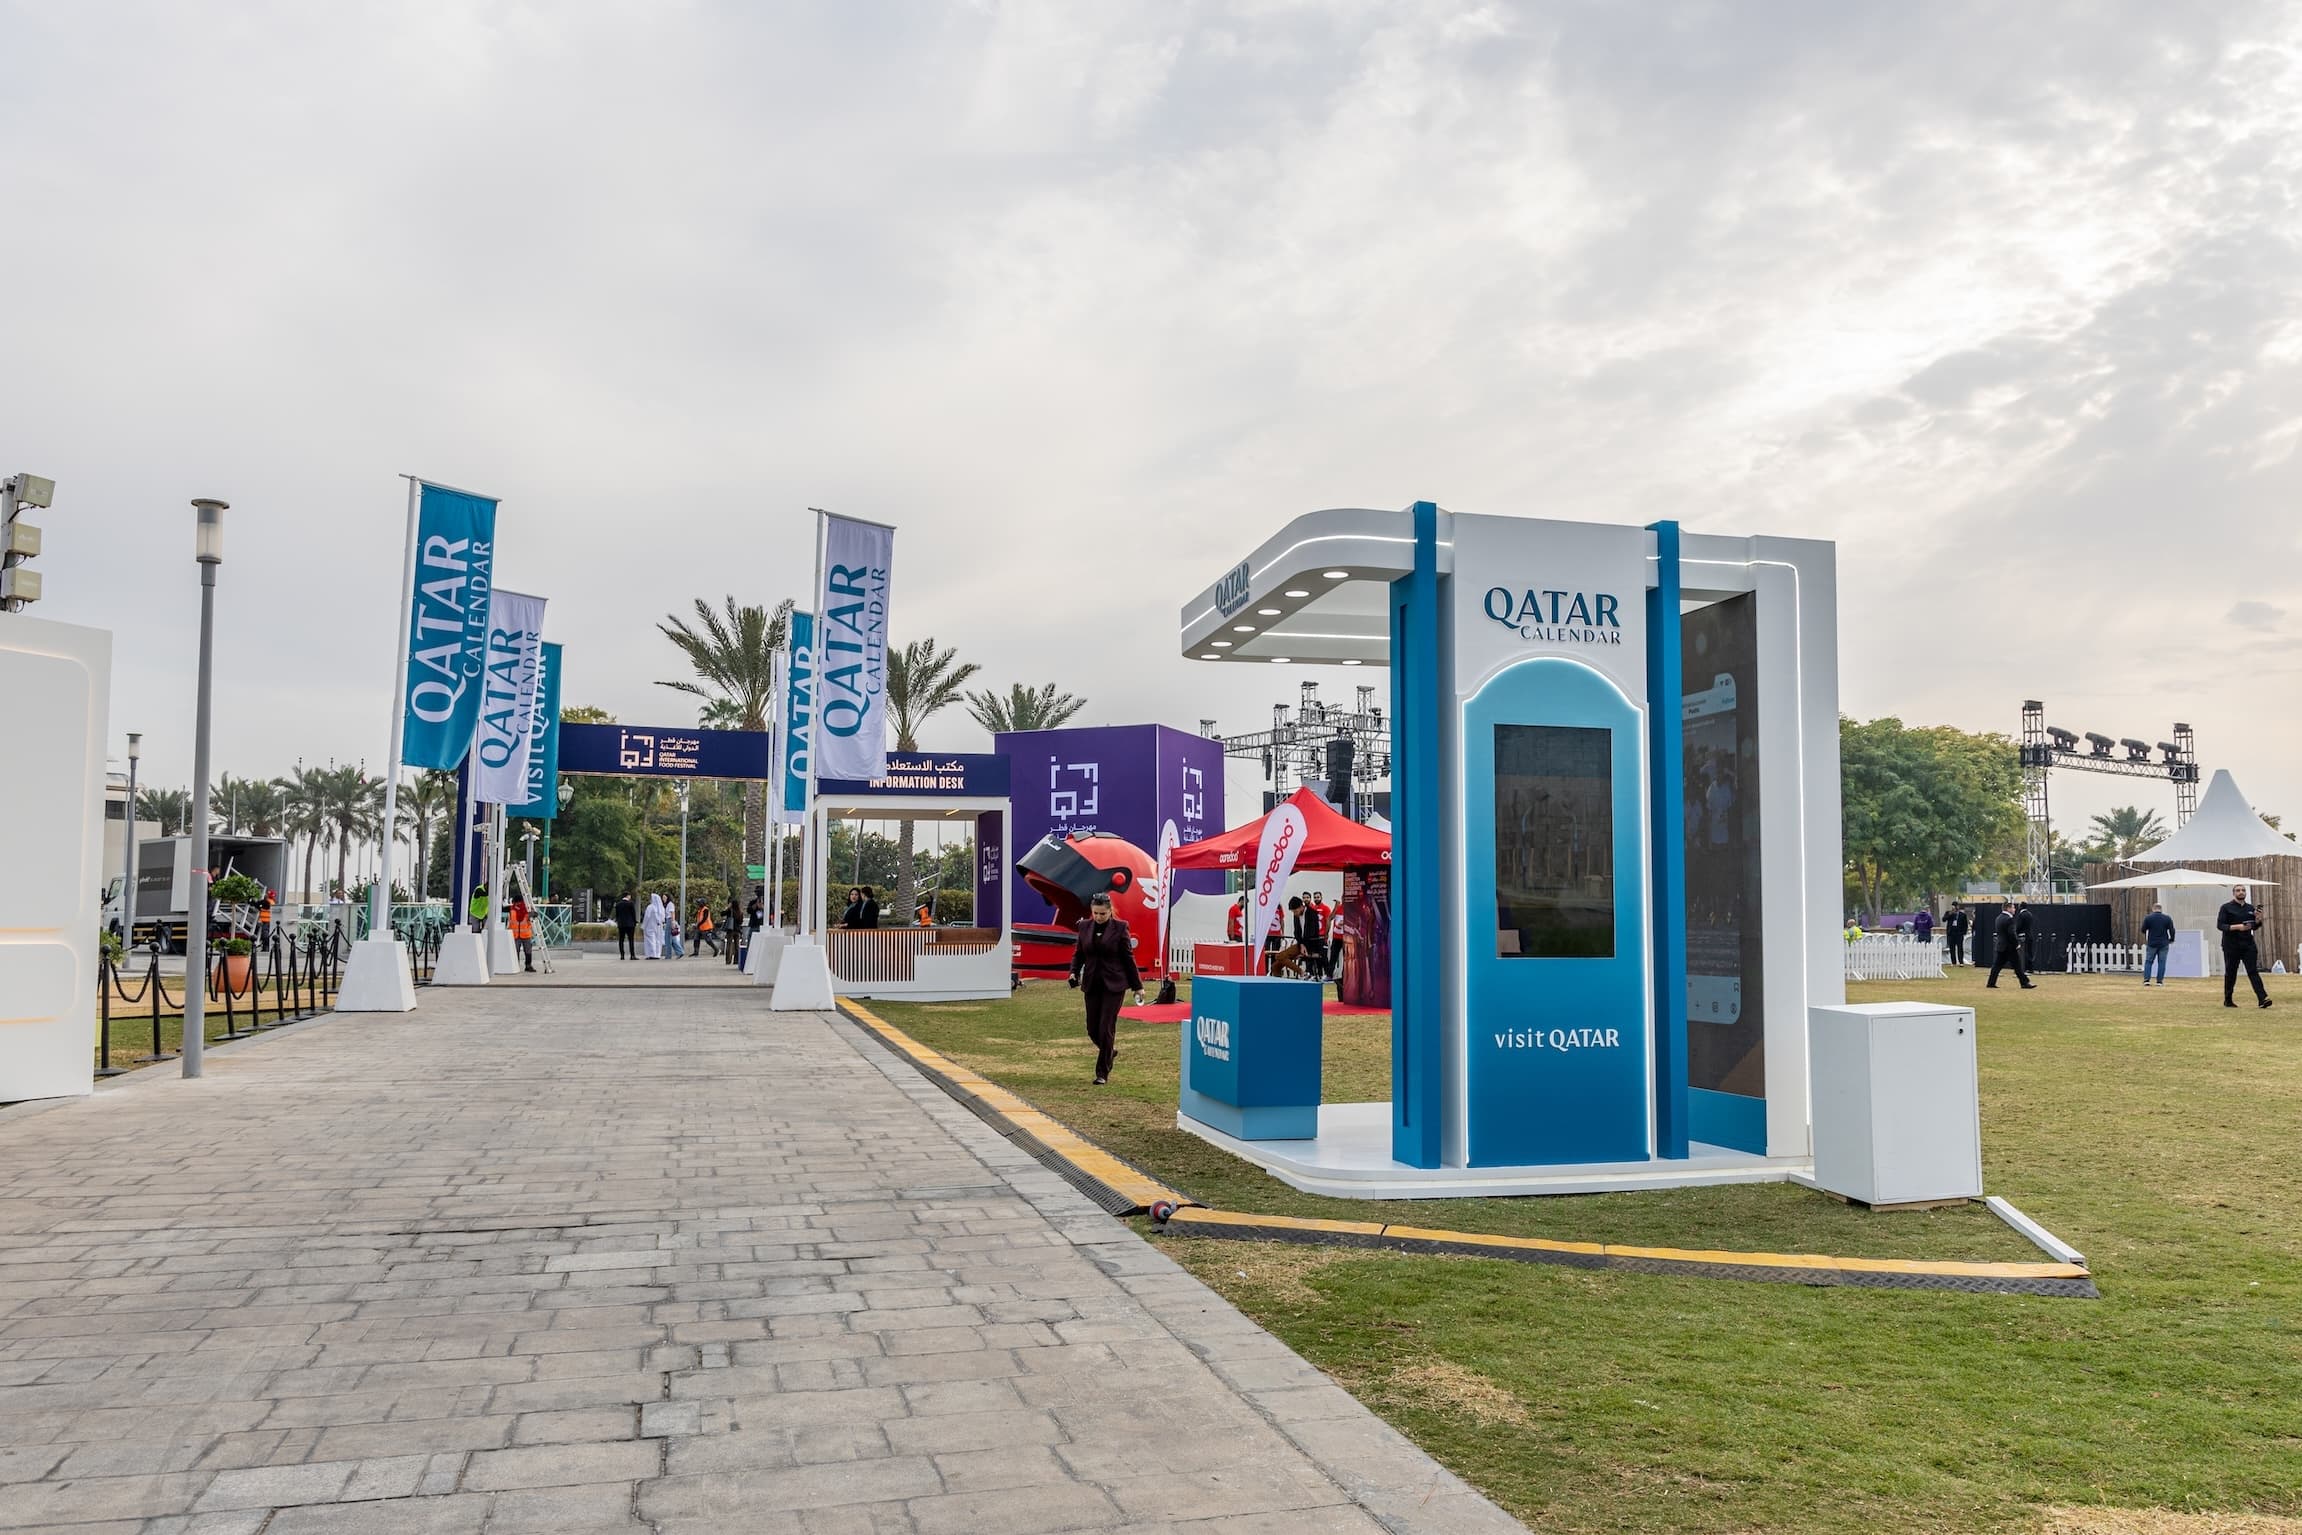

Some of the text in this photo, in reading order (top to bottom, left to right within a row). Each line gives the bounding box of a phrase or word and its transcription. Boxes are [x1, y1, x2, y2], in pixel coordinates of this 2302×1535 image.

[462, 541, 491, 680] CALENDAR
[1215, 562, 1249, 613] QATAR
[1484, 586, 1621, 630] QATAR
[411, 534, 469, 724] QATAR
[822, 563, 870, 738] QATAR
[865, 568, 886, 695] CALENDAR
[1520, 625, 1621, 645] CALENDAR
[480, 627, 523, 769] QATAR
[517, 630, 539, 736] CALENDAR
[869, 776, 965, 789] INFORMATION DESK
[886, 759, 964, 774] مكتب الاستعلام
[1219, 850, 1239, 864] ooredoo
[1259, 819, 1294, 906] ooredoo
[1196, 1015, 1230, 1049] QATAR
[1494, 1028, 1620, 1052] visit QATAR
